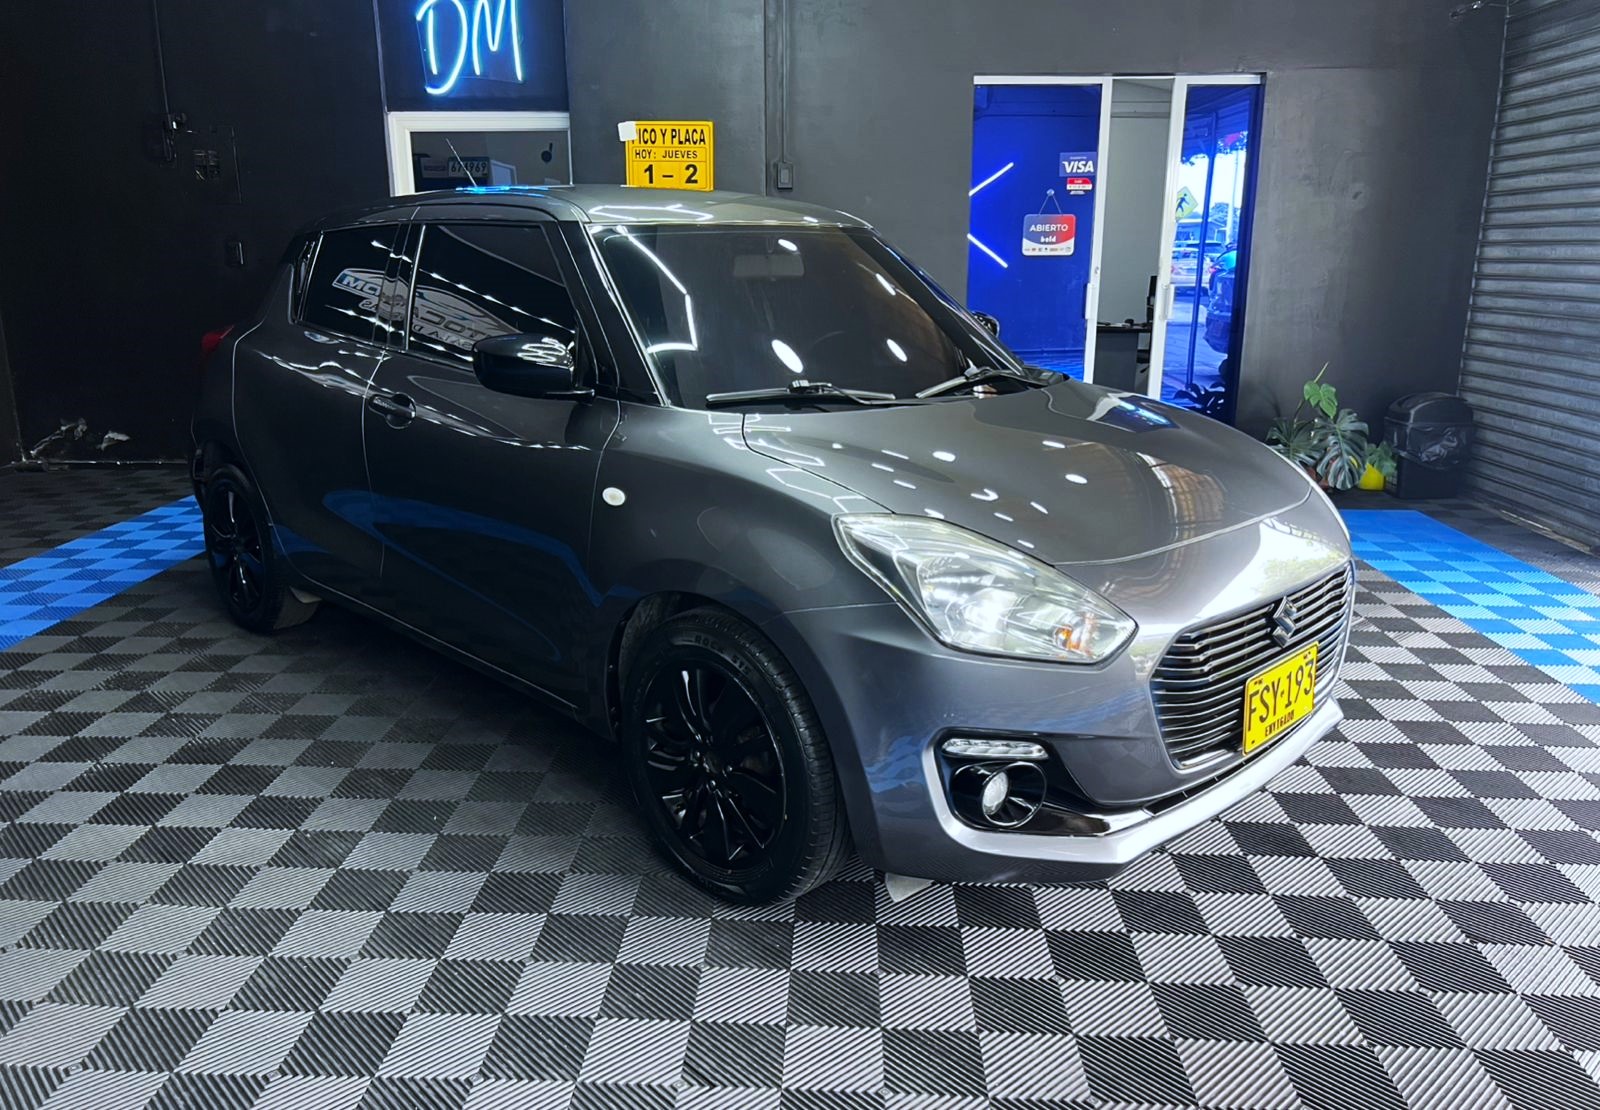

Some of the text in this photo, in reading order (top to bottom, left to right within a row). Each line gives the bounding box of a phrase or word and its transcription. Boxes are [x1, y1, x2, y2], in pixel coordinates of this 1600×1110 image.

[416, 0, 524, 95] DM
[631, 128, 706, 145] ICO Y PLACA
[634, 149, 698, 159] HOY: JUEVES
[1062, 160, 1094, 173] VISA
[644, 163, 654, 184] 1
[685, 163, 698, 184] 2
[1029, 223, 1069, 232] ABIERTO
[1040, 235, 1056, 243] bold
